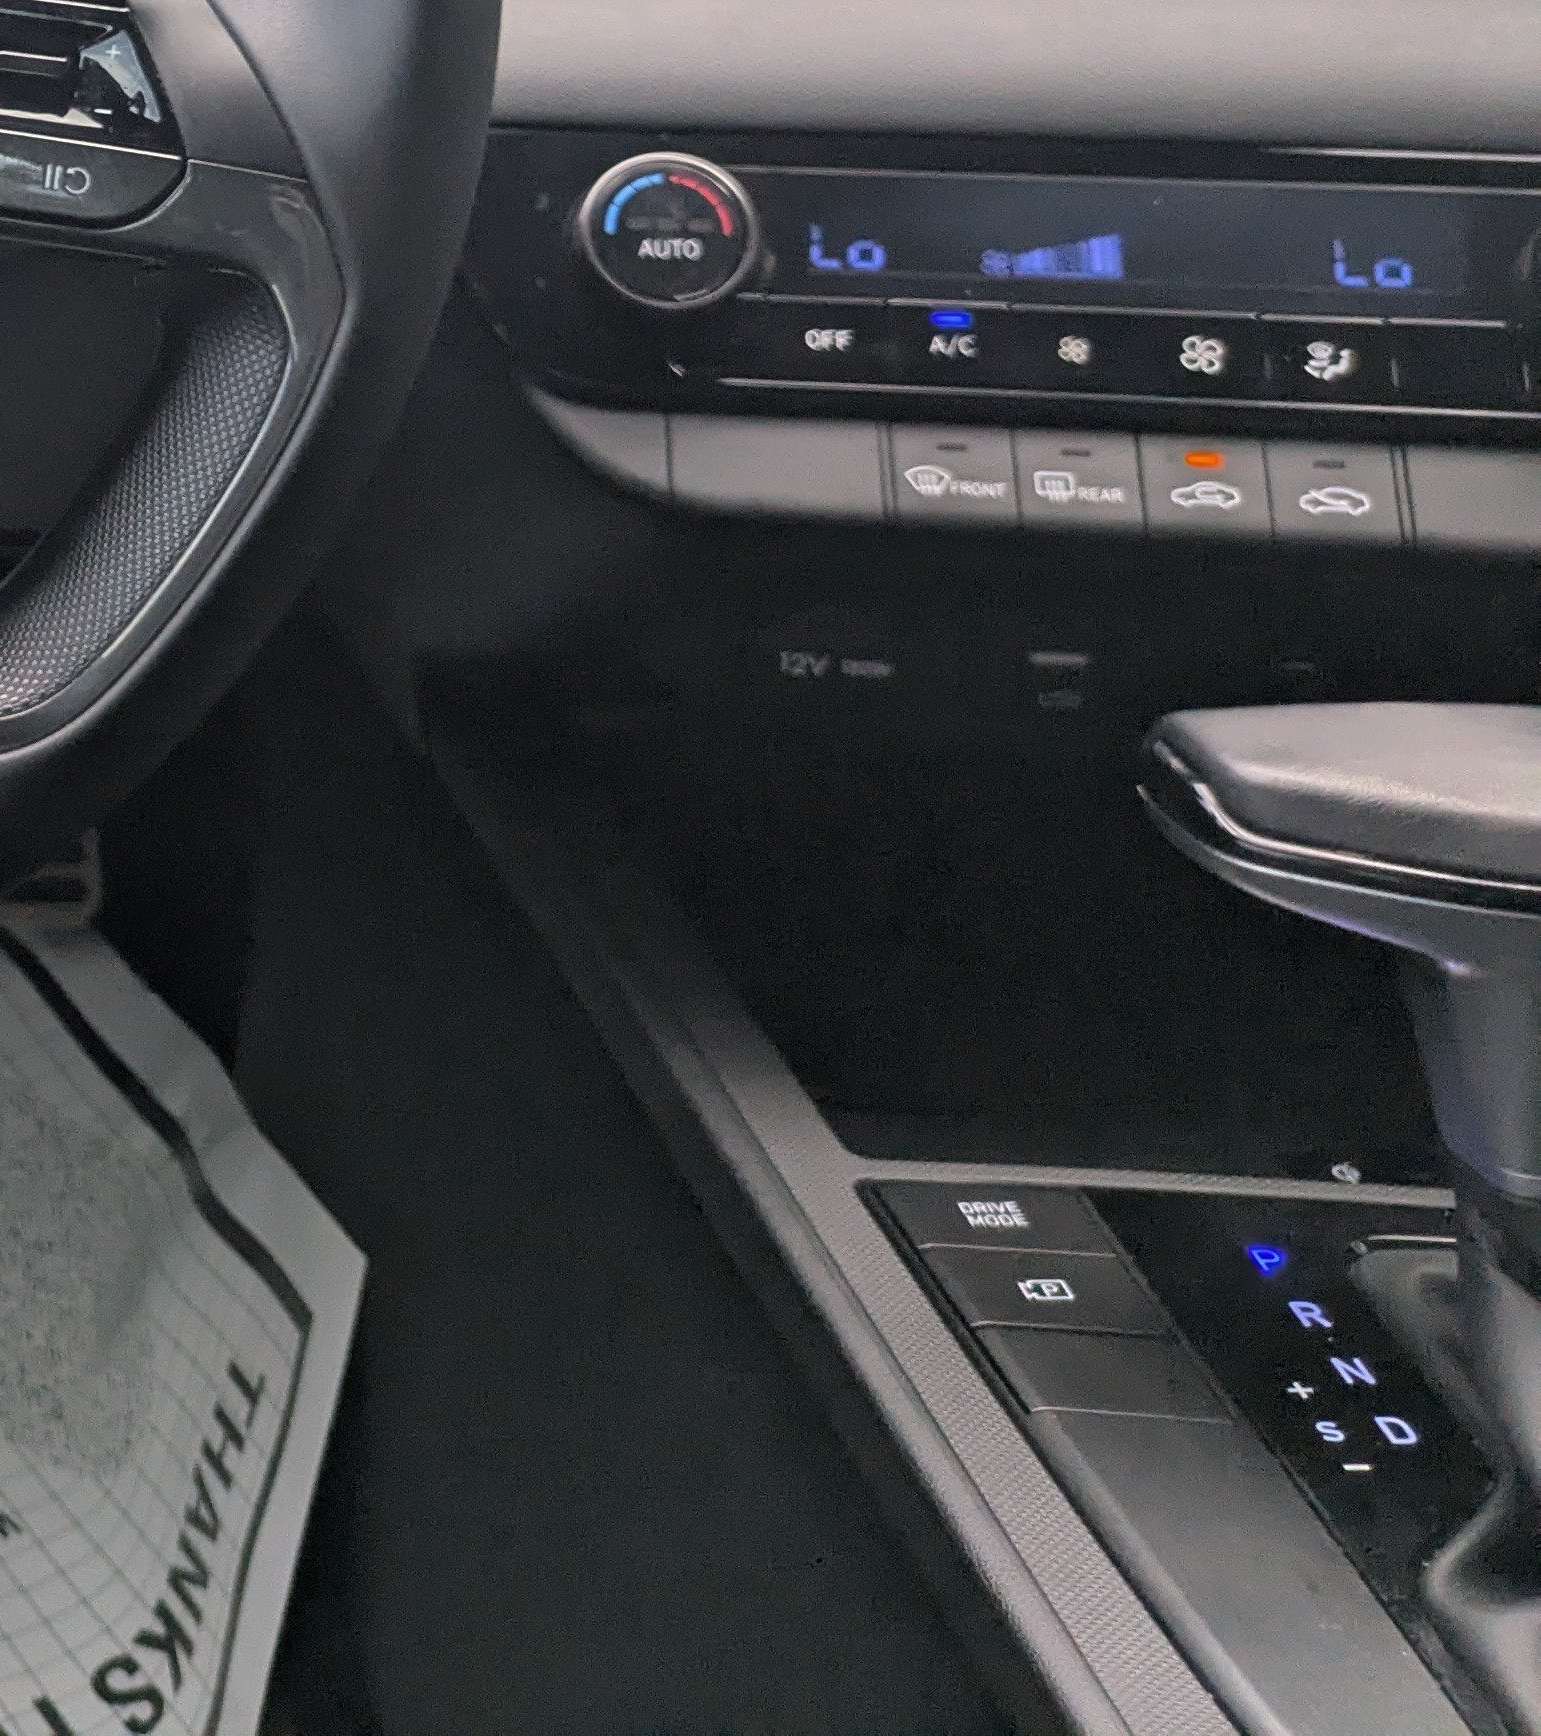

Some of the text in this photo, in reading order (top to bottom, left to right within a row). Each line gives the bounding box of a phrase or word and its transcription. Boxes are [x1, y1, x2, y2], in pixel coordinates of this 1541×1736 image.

[638, 238, 704, 261] AUTO
[805, 328, 852, 353] OFF
[929, 334, 979, 359] A/C
[950, 479, 1006, 500] FRONT
[1077, 484, 1125, 505] REAR
[958, 1200, 1022, 1216] DRIVE
[965, 1213, 1030, 1229] MODE
[1249, 1246, 1284, 1273] P
[1288, 1300, 1334, 1330] R
[1330, 1357, 1378, 1388] N
[1317, 1419, 1345, 1444] S
[1375, 1416, 1421, 1446] D
[90, 1361, 266, 1735] THANKS
